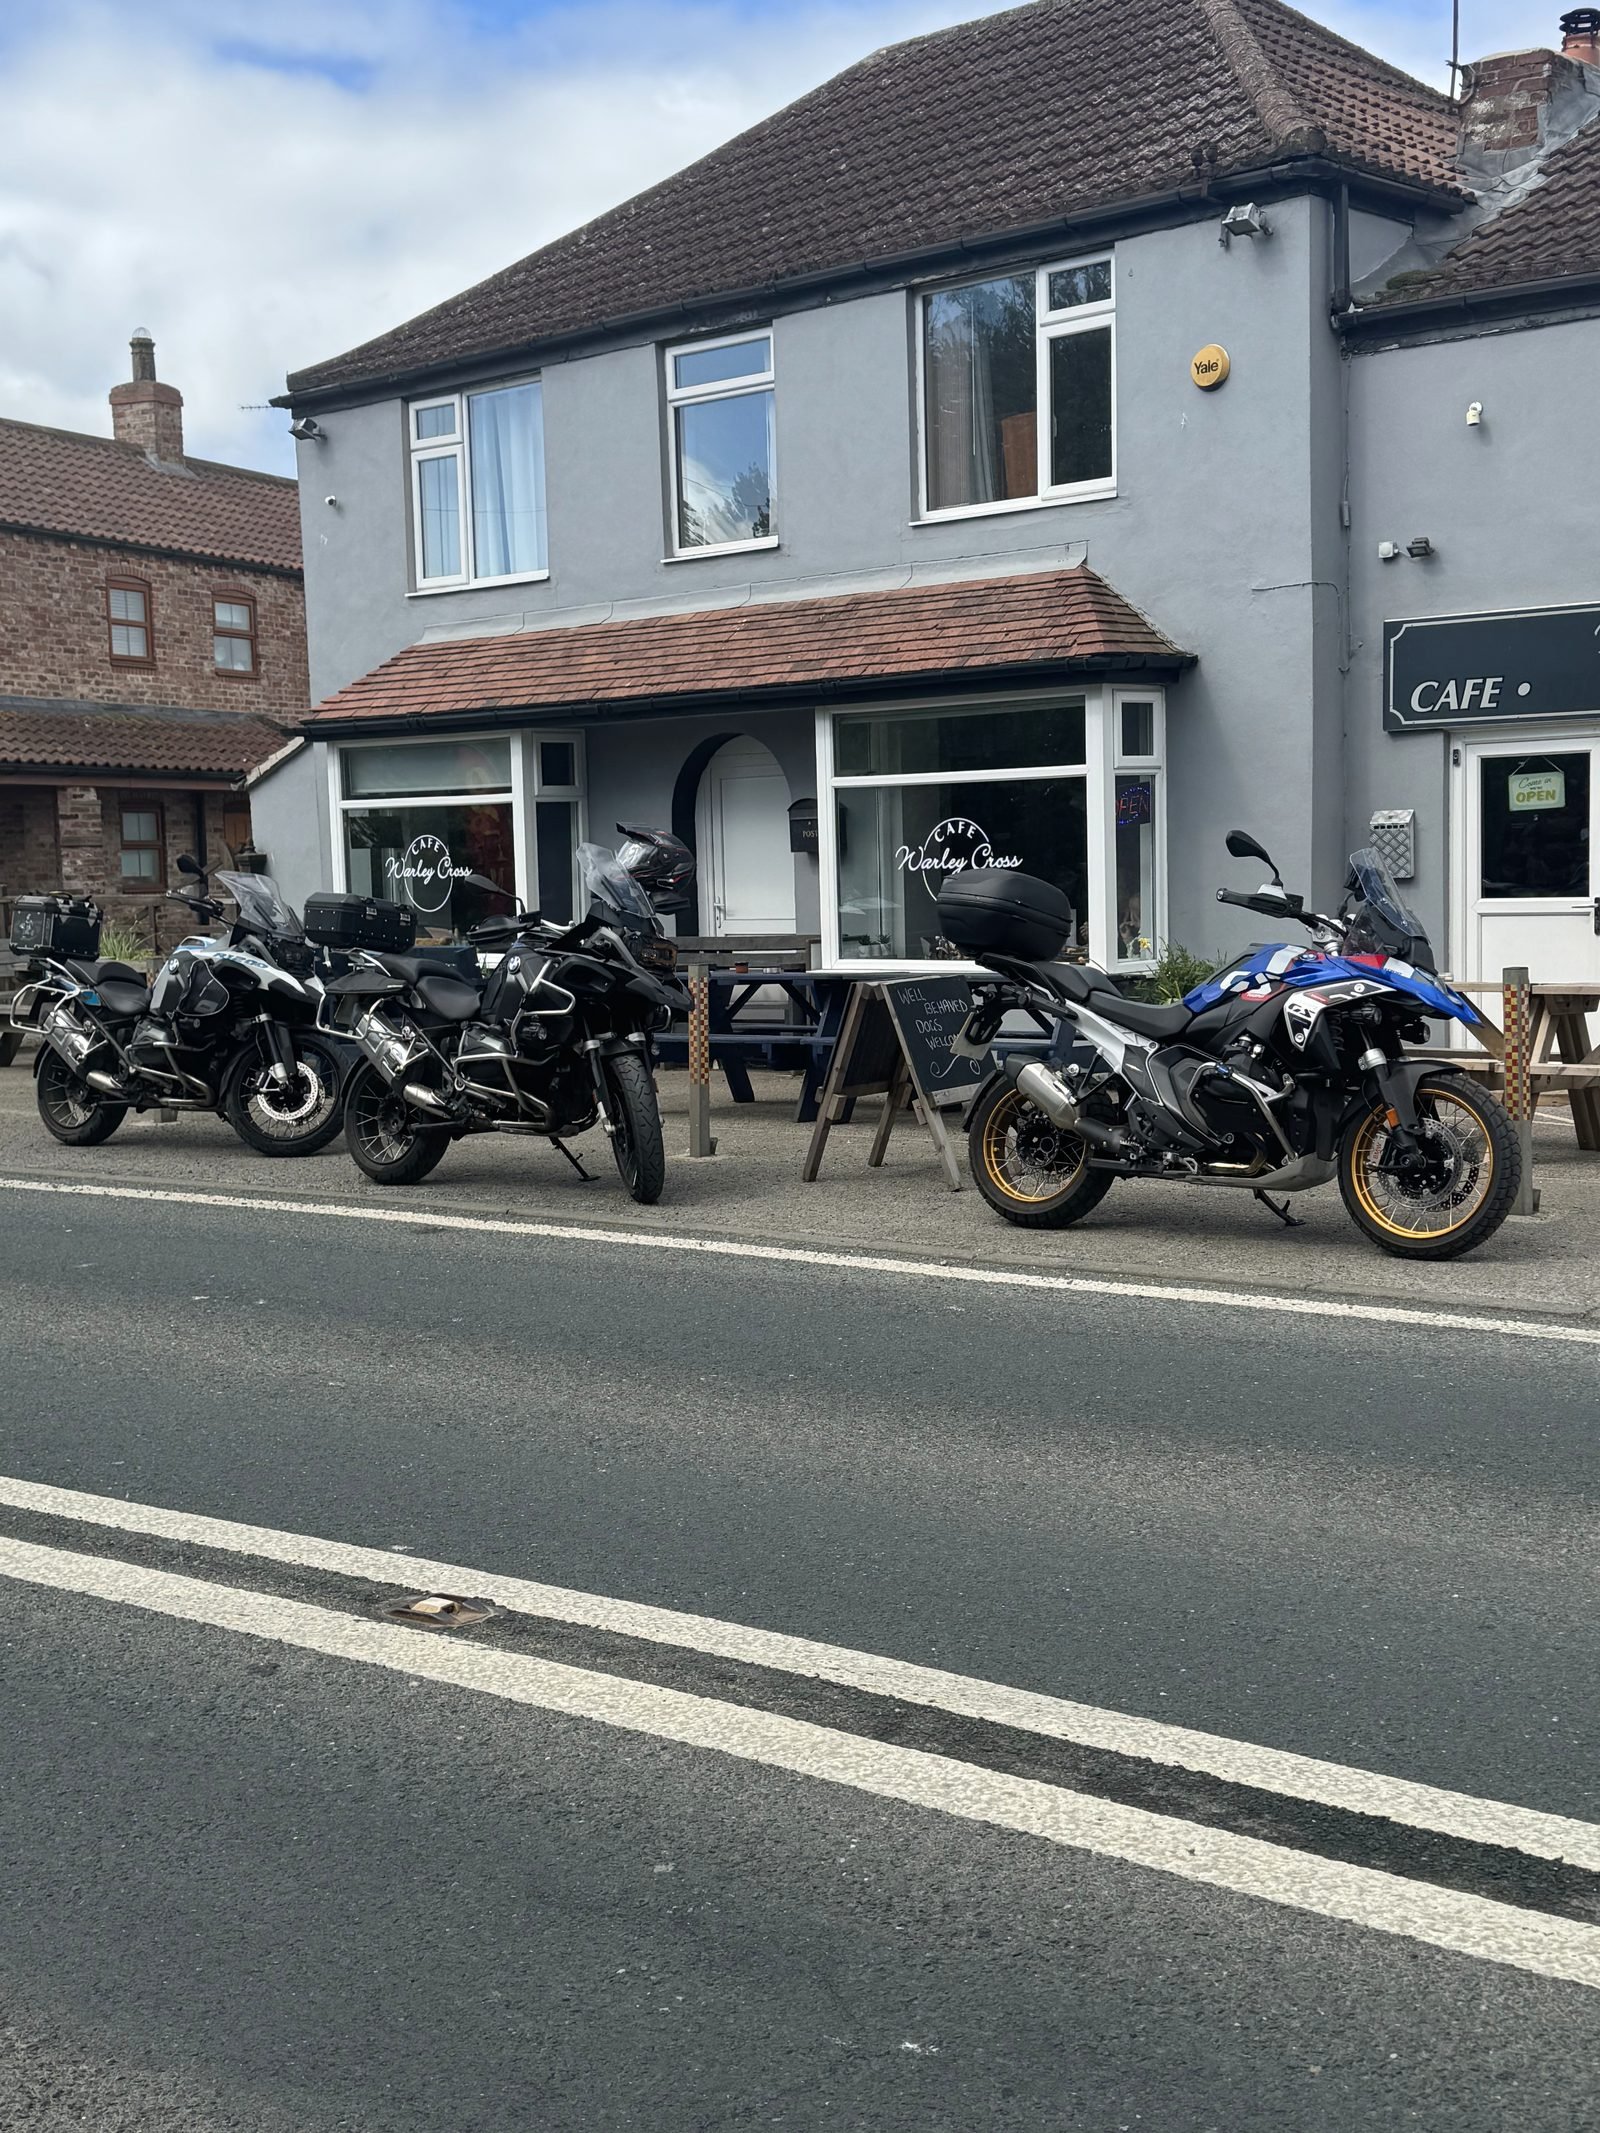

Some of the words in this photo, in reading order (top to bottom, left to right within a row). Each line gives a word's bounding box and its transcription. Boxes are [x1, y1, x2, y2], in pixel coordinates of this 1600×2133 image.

[1194, 359, 1219, 375] Yale
[1410, 677, 1503, 713] CAFE
[1515, 789, 1556, 803] OPEN
[934, 821, 977, 842] CAFE
[411, 837, 440, 855] CAFE
[895, 845, 968, 875] Warley
[971, 843, 1023, 869] Cross
[385, 856, 435, 885] Warley
[437, 856, 473, 879] Cross
[897, 986, 926, 1005] WELL
[924, 998, 968, 1015] BEHAVED
[915, 1018, 943, 1034] DOGS
[925, 1033, 960, 1050] WELCO
